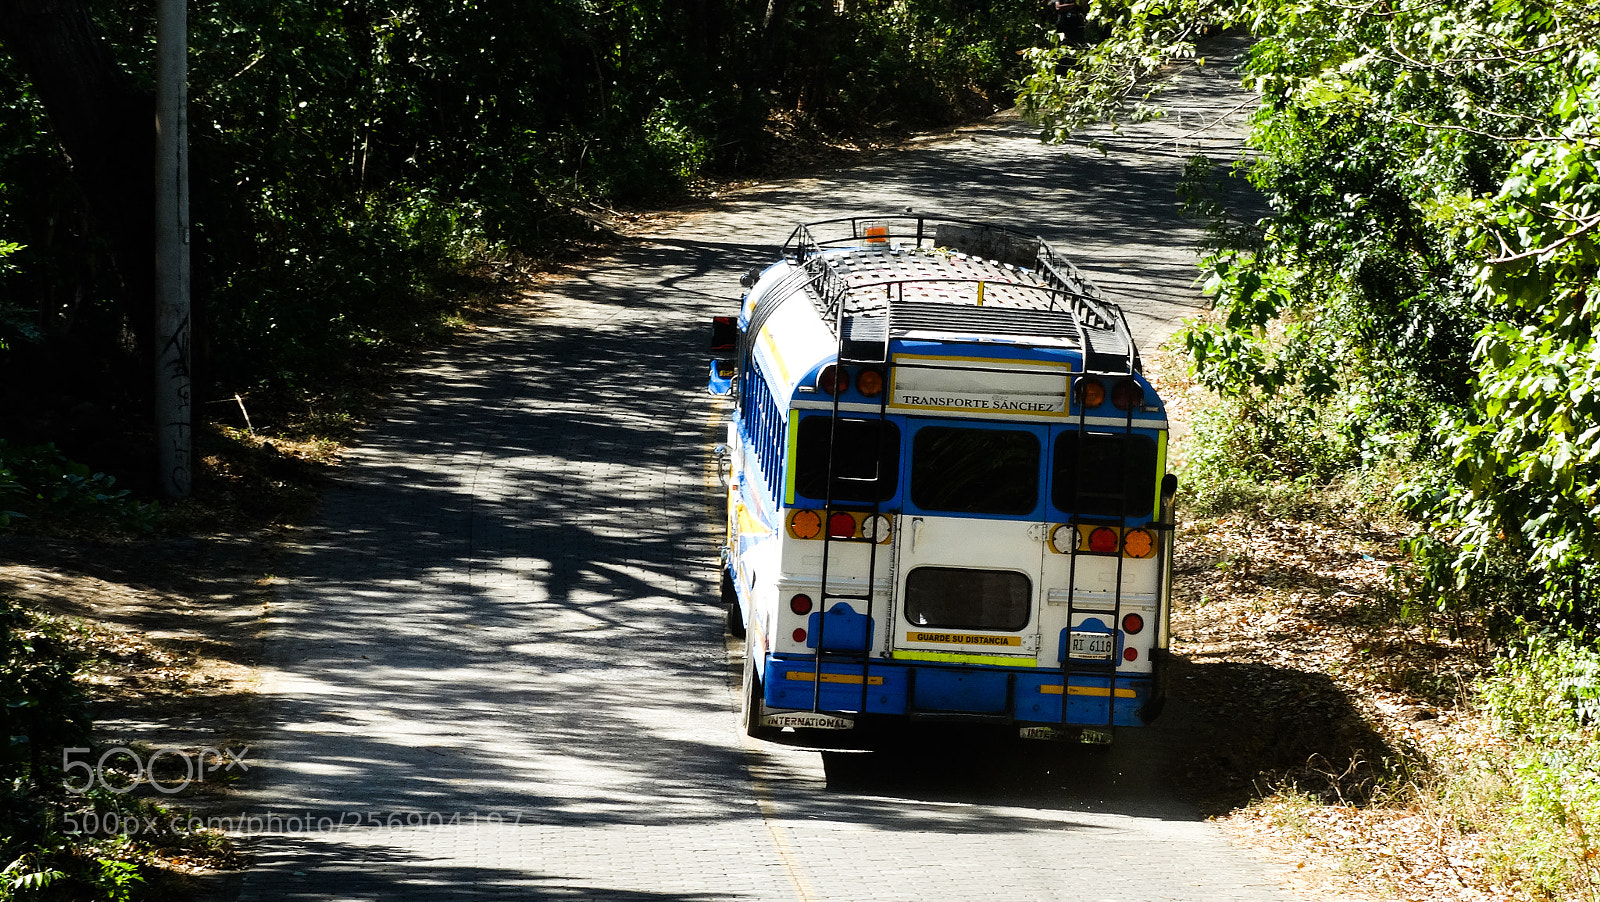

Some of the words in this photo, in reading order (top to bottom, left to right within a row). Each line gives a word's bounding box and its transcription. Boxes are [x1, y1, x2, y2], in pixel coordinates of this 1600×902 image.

[902, 395, 990, 409] TRANSPORTE
[992, 399, 1054, 412] SÁNCHEZ
[917, 633, 950, 642] GUARDE
[952, 635, 964, 643] SU
[966, 637, 1009, 645] DISTANCIA
[1072, 639, 1085, 651] RI
[1089, 640, 1112, 653] 6118
[768, 716, 846, 728] INTERNATIONAL
